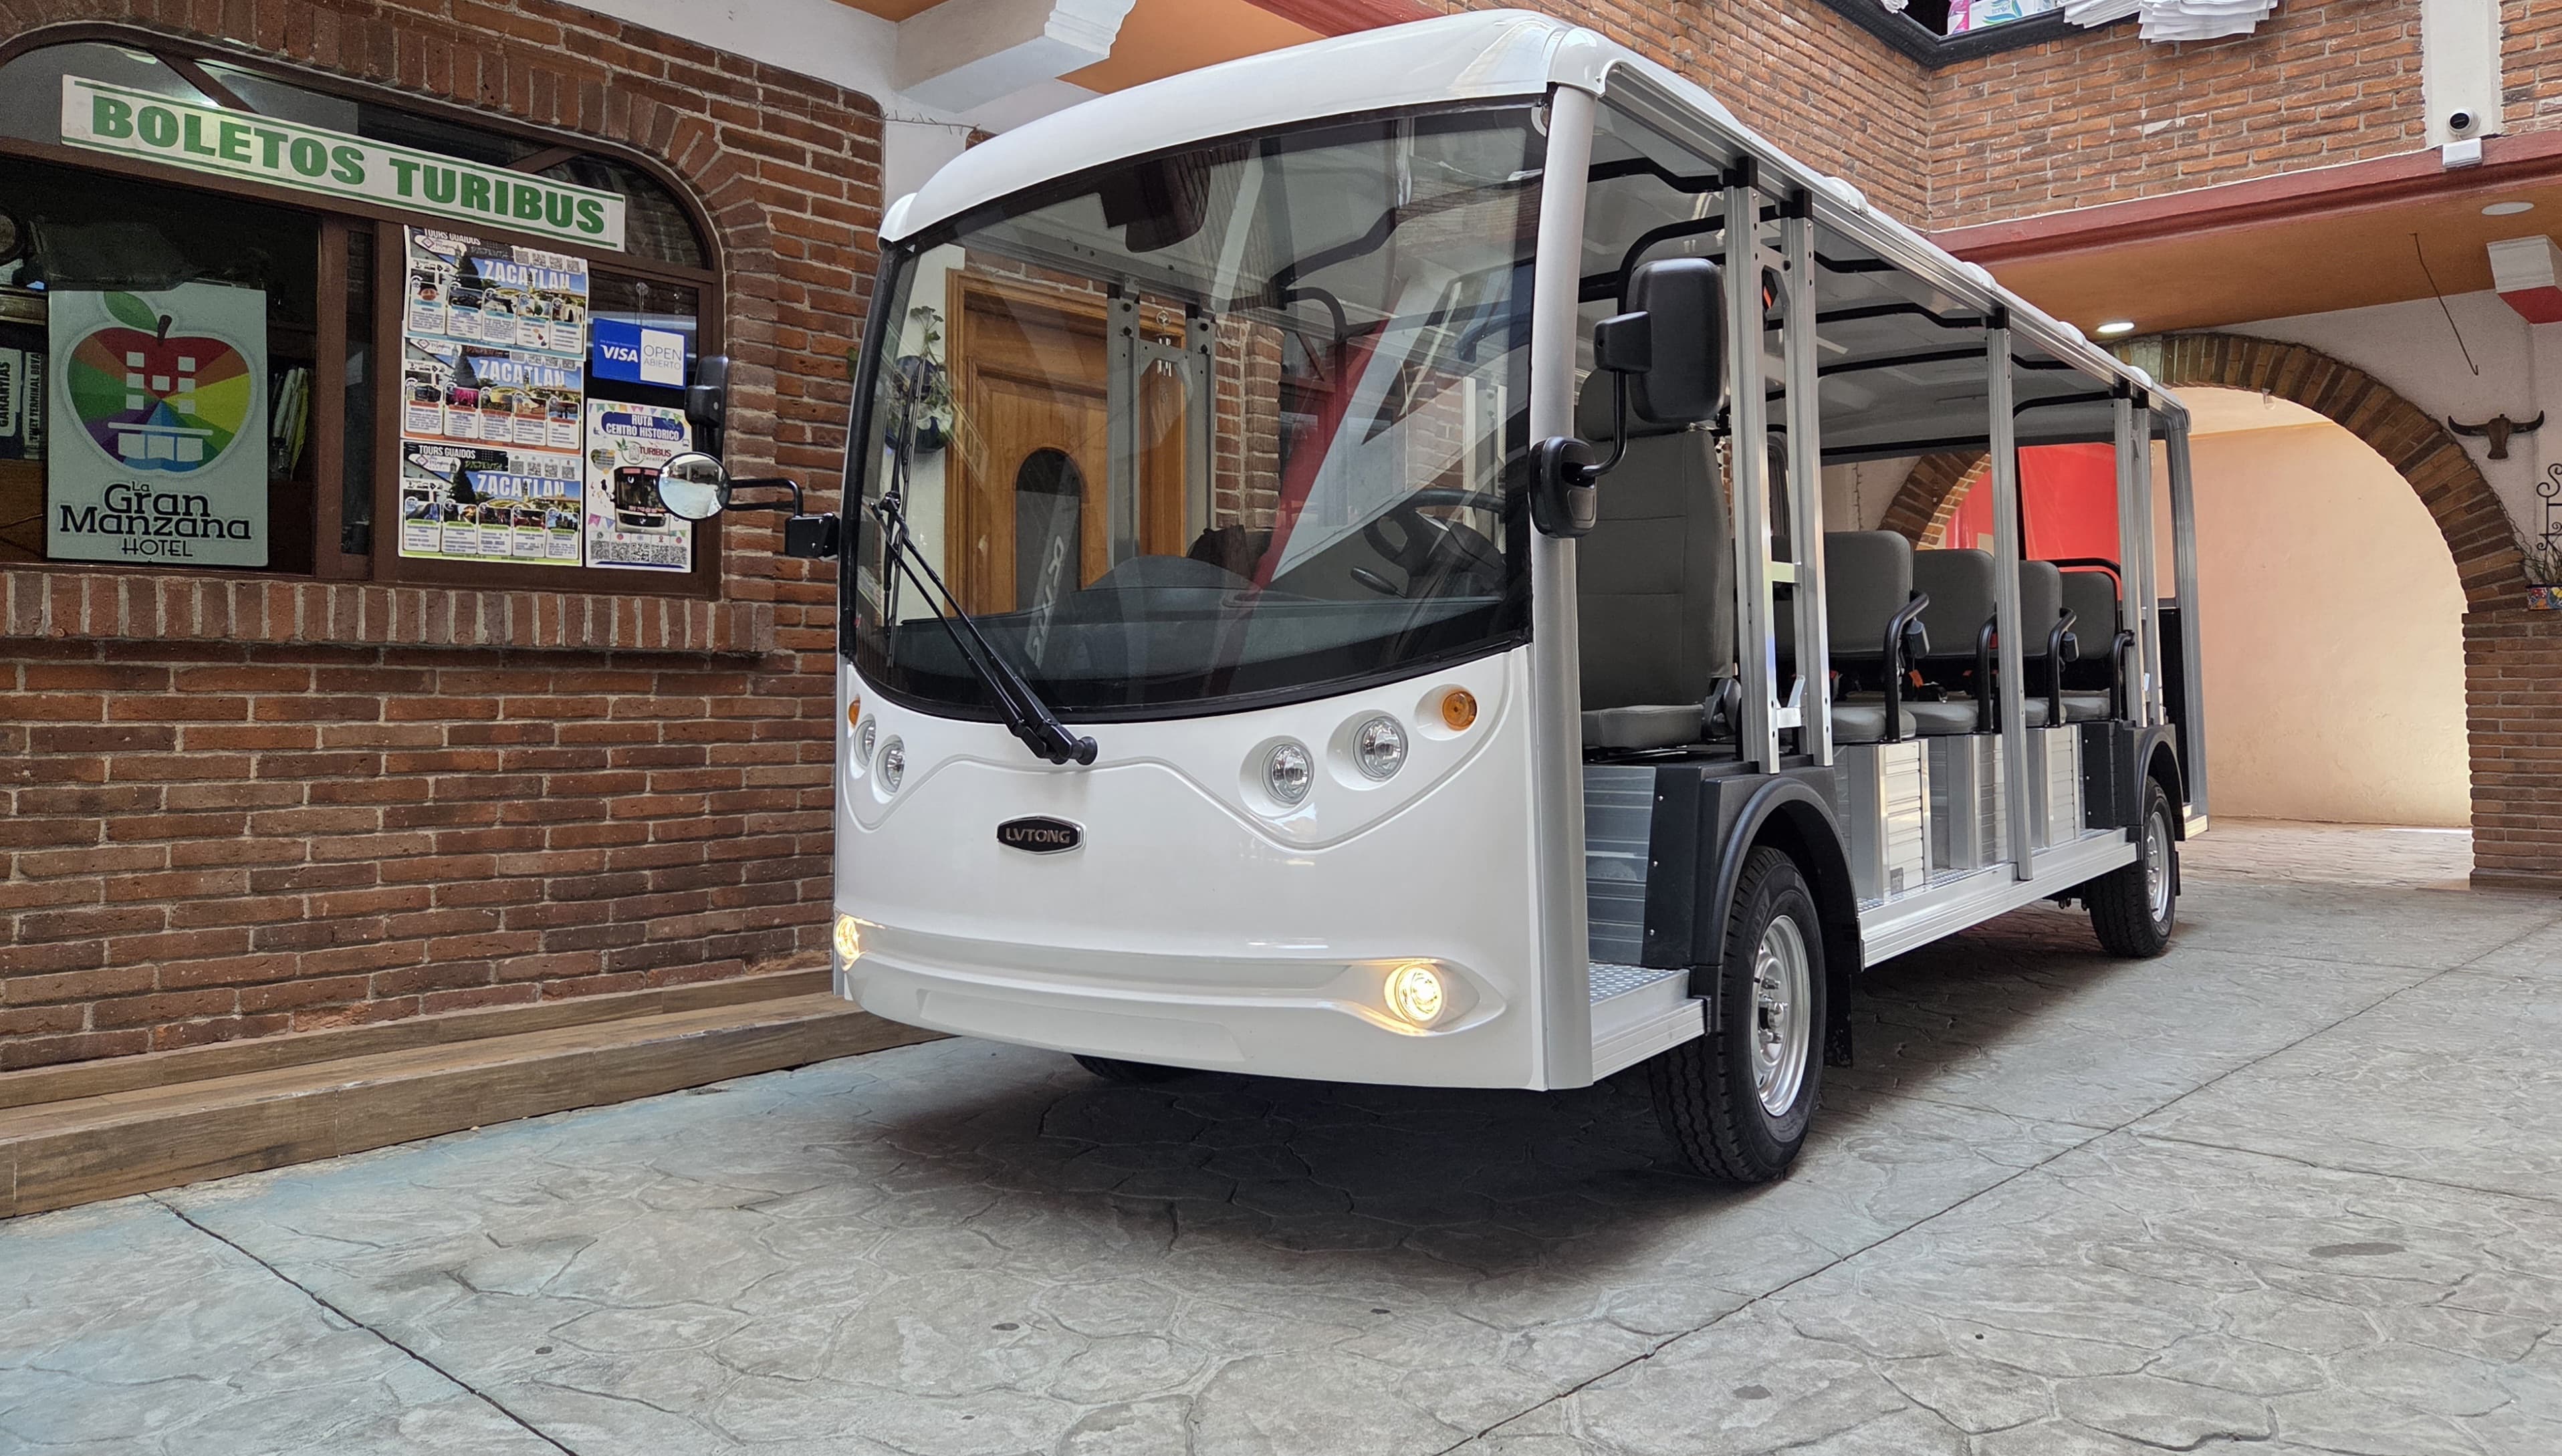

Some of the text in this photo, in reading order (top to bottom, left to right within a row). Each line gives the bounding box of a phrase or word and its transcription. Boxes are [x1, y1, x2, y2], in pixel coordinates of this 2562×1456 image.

[92, 95, 605, 234] BOLETOS TURIBUS
[600, 344, 638, 363] VISA
[643, 344, 682, 362] OPEN
[643, 358, 682, 370] ABIERTO
[631, 414, 653, 427] RUTA
[606, 423, 679, 441] CENTRO HISTORICO
[418, 445, 443, 456] TOURS
[639, 446, 672, 457] TURIBUS
[132, 481, 150, 492] La
[104, 483, 211, 517] Gran
[60, 505, 251, 539] Manzana
[122, 537, 193, 557] HOTEL
[1006, 828, 1070, 844] LVTONG
